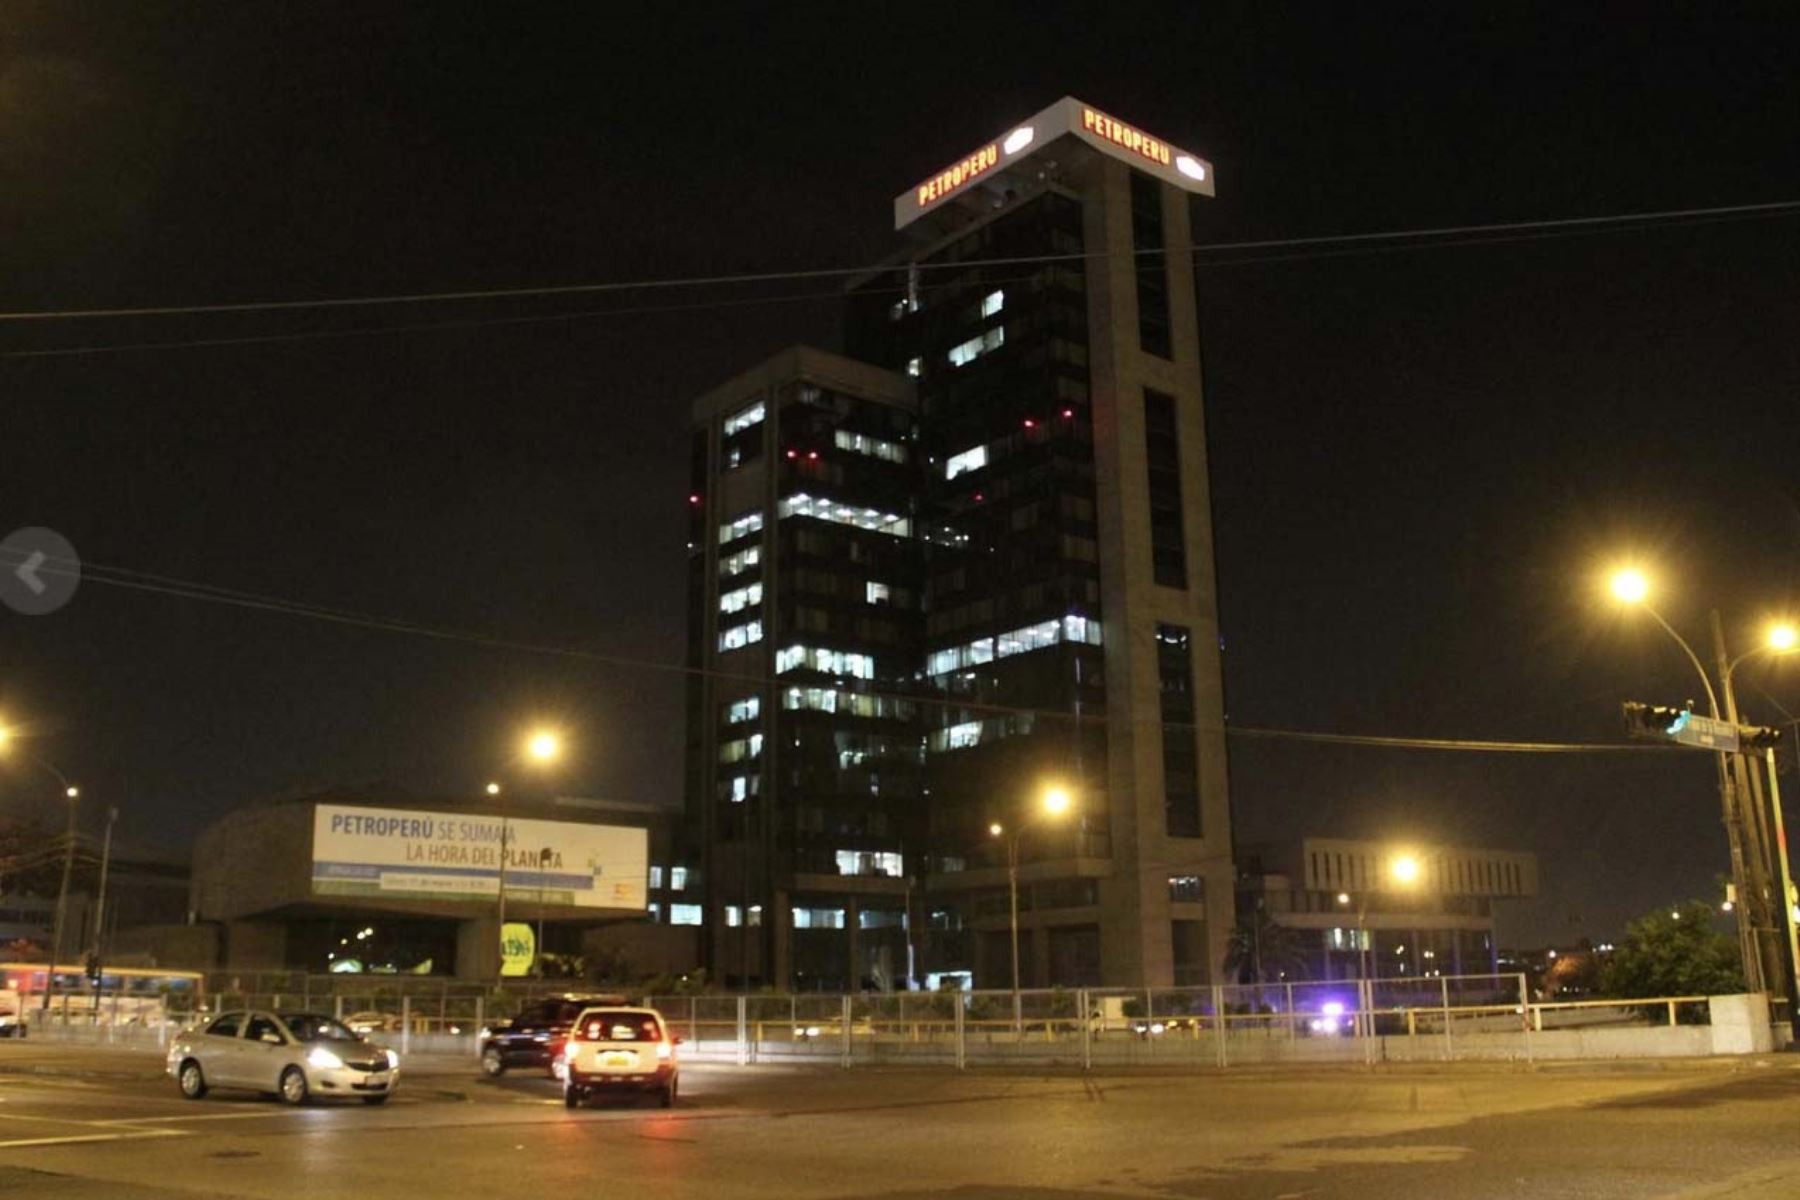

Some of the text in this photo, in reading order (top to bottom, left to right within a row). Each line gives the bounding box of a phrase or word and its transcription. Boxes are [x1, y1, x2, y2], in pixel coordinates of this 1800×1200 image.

[331, 814, 433, 839] PETROPERÚ
[438, 822, 456, 841] SE
[460, 823, 503, 843] SUMA
[406, 842, 424, 861] LA
[428, 844, 469, 864] HORA
[472, 847, 496, 866] DEL
